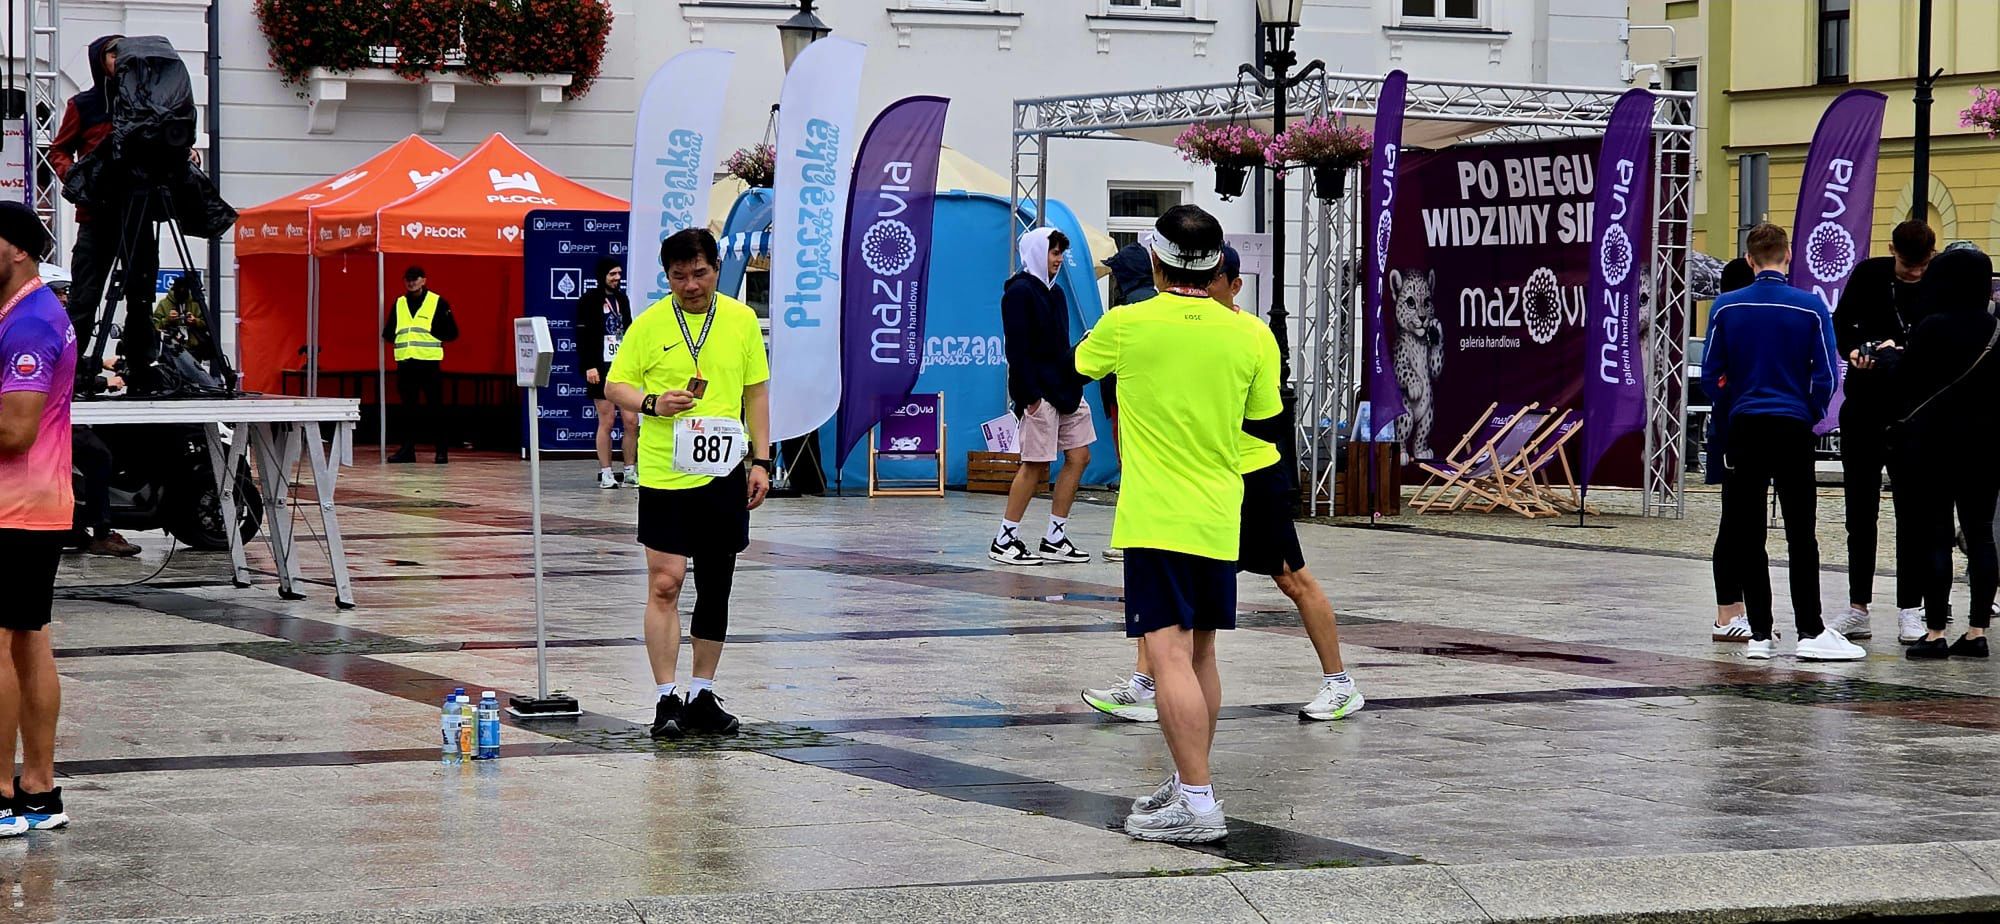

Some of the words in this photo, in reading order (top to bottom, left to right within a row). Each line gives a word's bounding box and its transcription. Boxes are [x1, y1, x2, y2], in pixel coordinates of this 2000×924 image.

[676, 133, 703, 191] kranu
[814, 124, 840, 187] kranu
[1457, 160, 1499, 200] PO
[1503, 154, 1594, 198] BIEGU
[487, 194, 558, 206] PŁOCK
[821, 191, 836, 204] z
[401, 225, 405, 236] I
[424, 226, 467, 238] PŁOCK
[596, 222, 621, 230] PPPT
[812, 207, 839, 281] prosto
[1421, 204, 1551, 248] WIDZIMY
[570, 244, 596, 252] PPPT
[908, 280, 919, 330] handlowa
[1460, 267, 1586, 345] mazovi
[1619, 293, 1630, 346] handlowa
[907, 331, 919, 365] galeria
[1460, 335, 1485, 351] galeria
[1486, 335, 1520, 348] handlowa
[1620, 348, 1636, 386] galeria
[692, 435, 733, 463] 887
